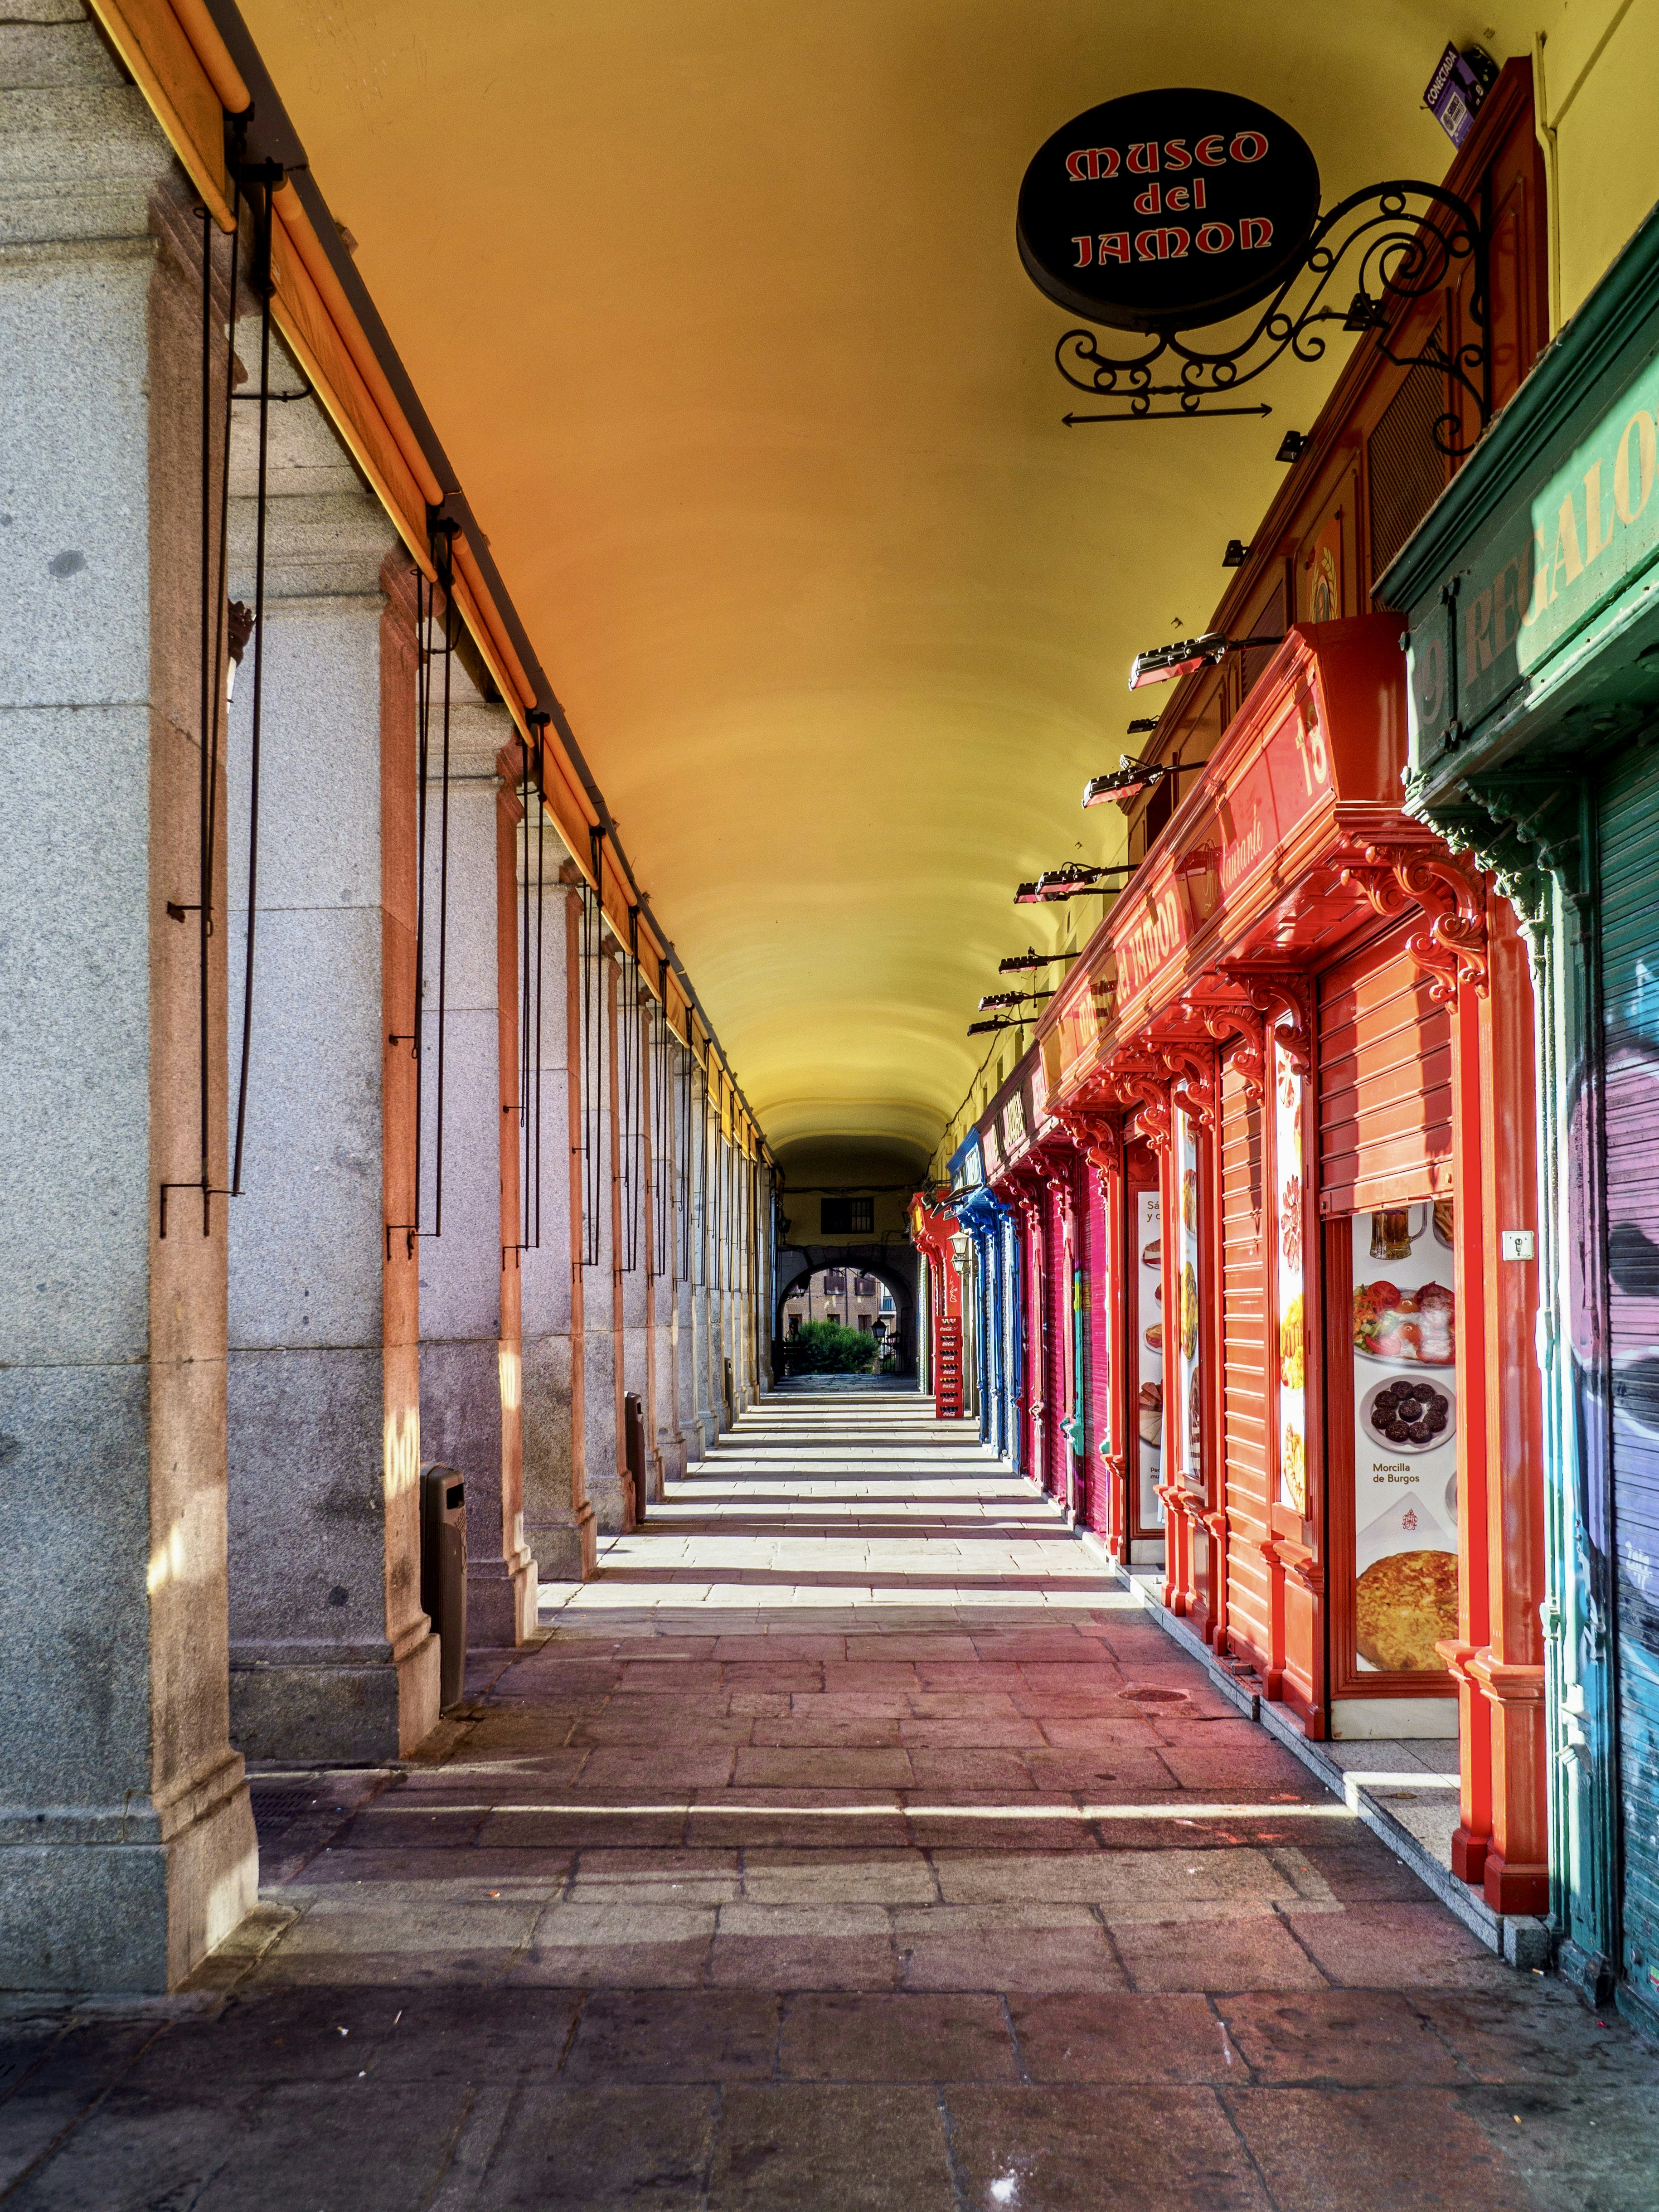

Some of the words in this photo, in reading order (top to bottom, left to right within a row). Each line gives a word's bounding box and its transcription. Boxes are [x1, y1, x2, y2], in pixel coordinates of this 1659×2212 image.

[1427, 50, 1457, 105] CONECTADA
[1066, 131, 1269, 181] MUSEO
[1134, 178, 1206, 214] del
[1071, 217, 1273, 267] JAMON
[1465, 399, 1659, 687] REGALO
[1295, 701, 1327, 796] 18
[1129, 890, 1180, 987] JAMON
[1373, 1463, 1410, 1471] Morcilla
[1387, 1474, 1420, 1484] Burgos
